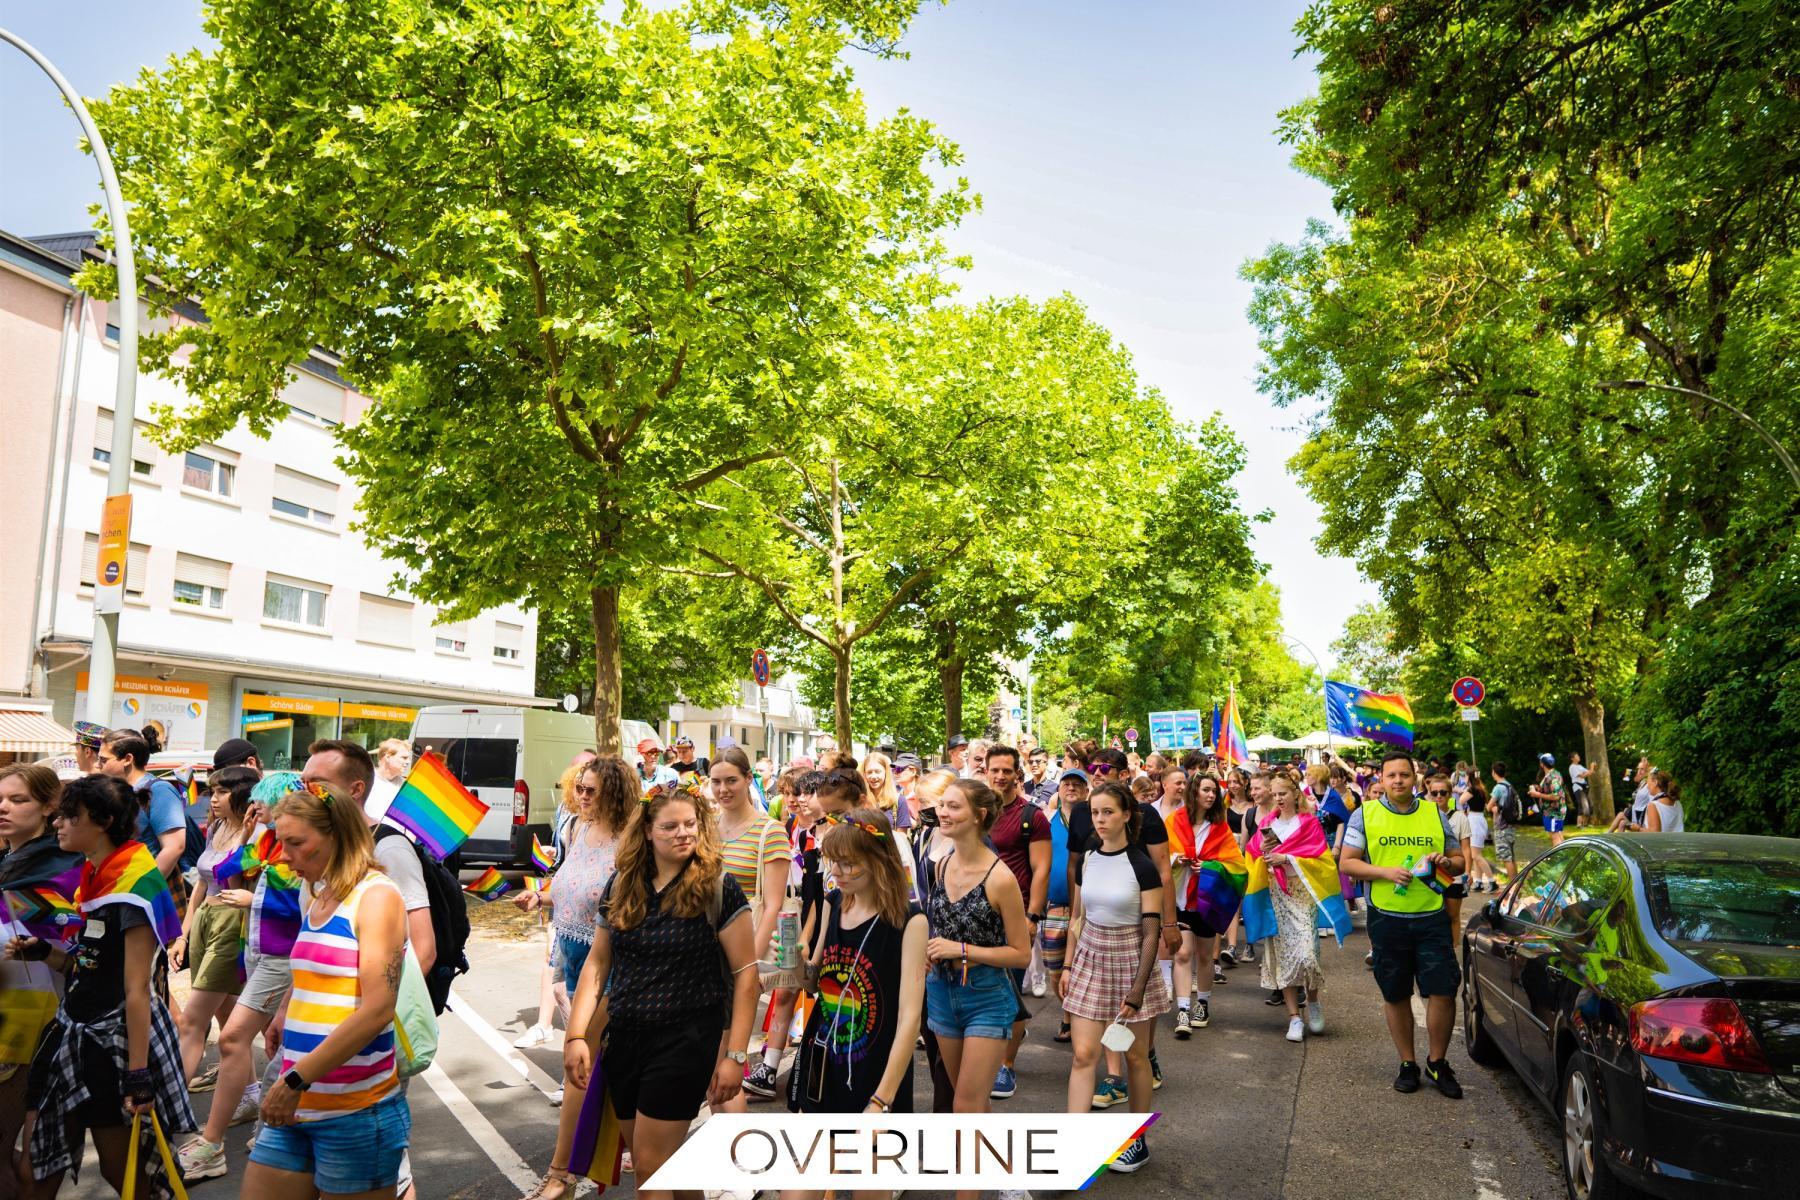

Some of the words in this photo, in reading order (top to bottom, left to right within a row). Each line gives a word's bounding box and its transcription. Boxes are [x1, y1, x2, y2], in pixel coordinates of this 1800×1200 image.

[121, 682, 149, 691] HEIZUNG
[149, 684, 162, 693] VON
[164, 684, 190, 694] SCHÄFER
[150, 701, 186, 714] SCHÄFER
[270, 700, 293, 711] Schöne
[295, 702, 315, 712] Bäder
[361, 707, 387, 718] Moderne
[388, 710, 408, 720] Wärme
[1379, 836, 1434, 847] ORDNER
